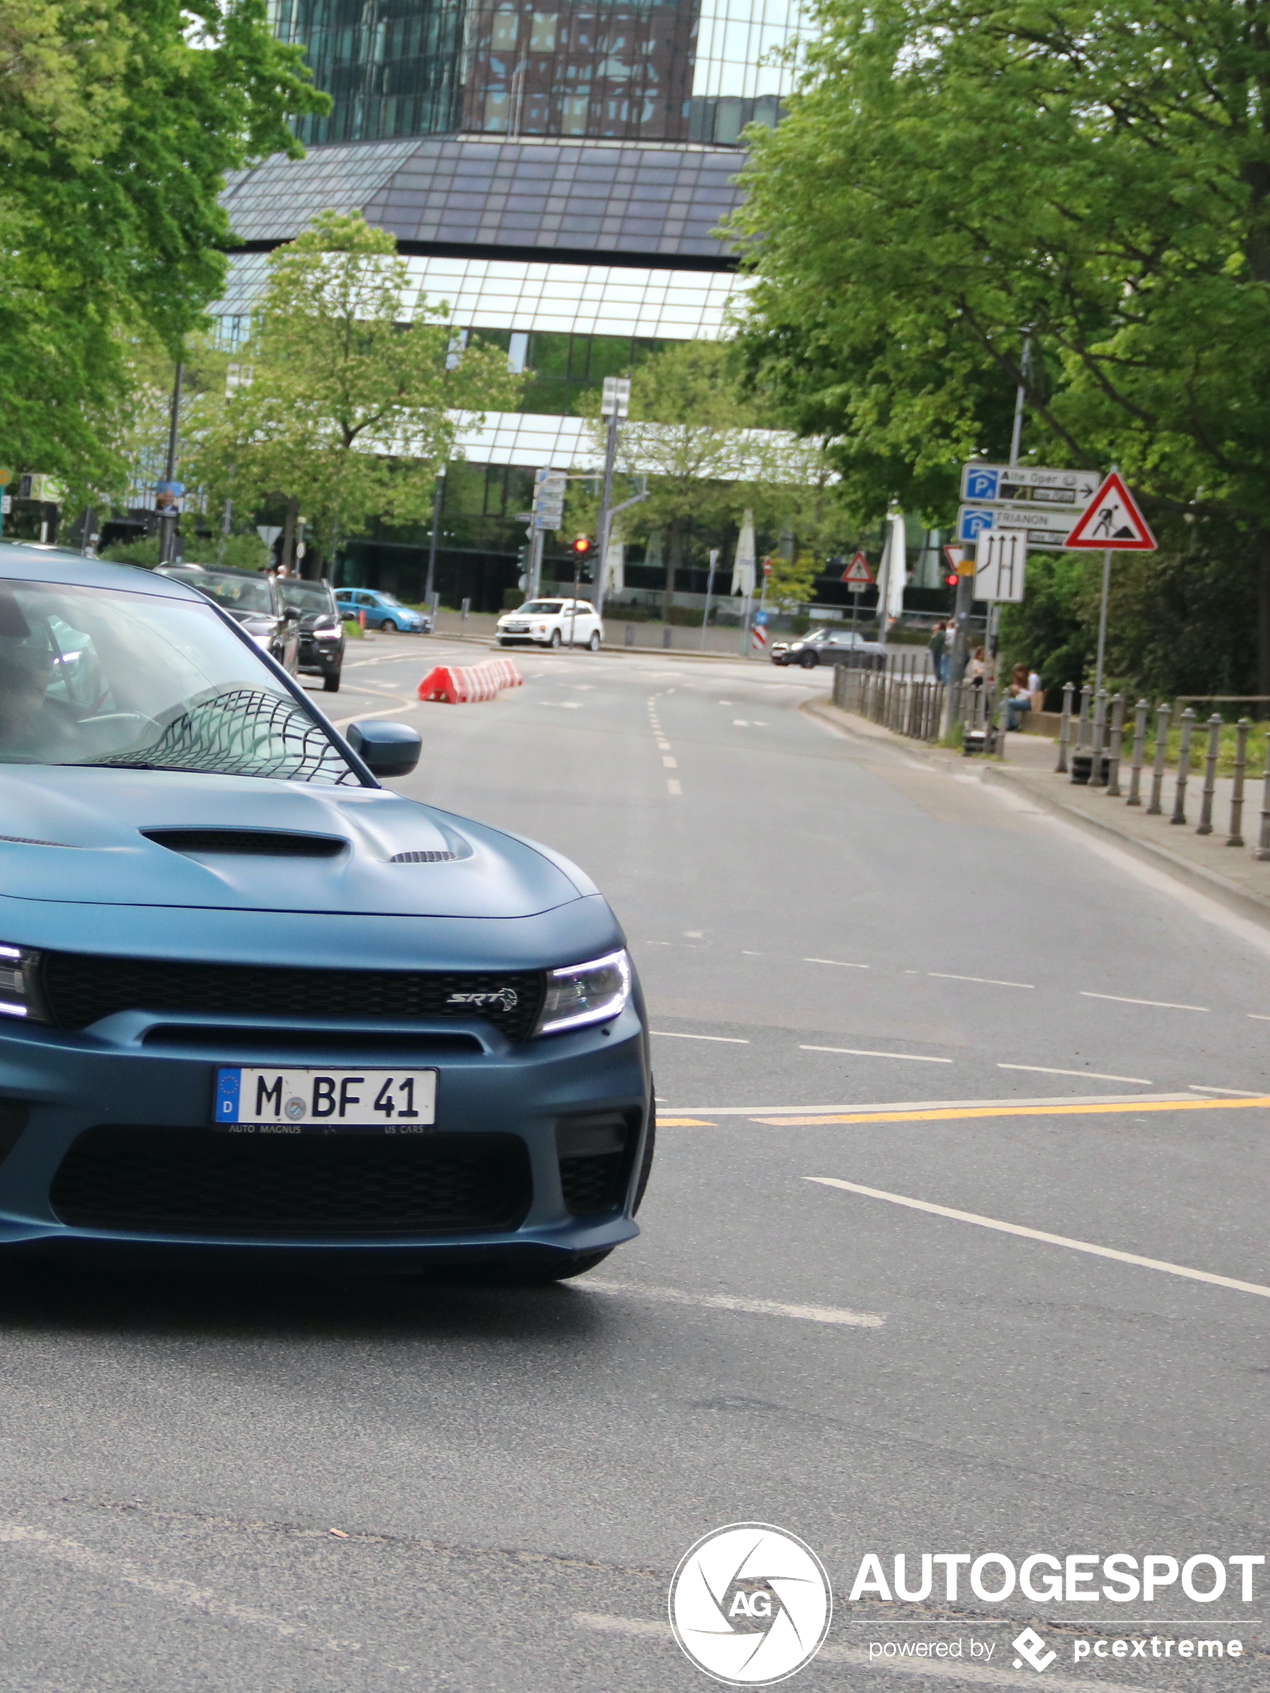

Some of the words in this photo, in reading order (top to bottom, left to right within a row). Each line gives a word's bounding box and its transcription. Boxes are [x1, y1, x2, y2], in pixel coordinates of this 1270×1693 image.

[1000, 471, 1025, 482] Alte
[1031, 473, 1057, 485] Oper
[975, 478, 989, 495] P
[996, 512, 1048, 525] TRIANON
[446, 993, 505, 1006] SRT
[256, 1075, 283, 1116] M
[312, 1077, 364, 1117] BF
[373, 1077, 419, 1118] 41
[223, 1101, 233, 1113] D
[229, 1125, 256, 1134] AUTO
[260, 1125, 301, 1134] MAGNUS
[384, 1125, 396, 1134] US
[400, 1125, 424, 1134] CARS
